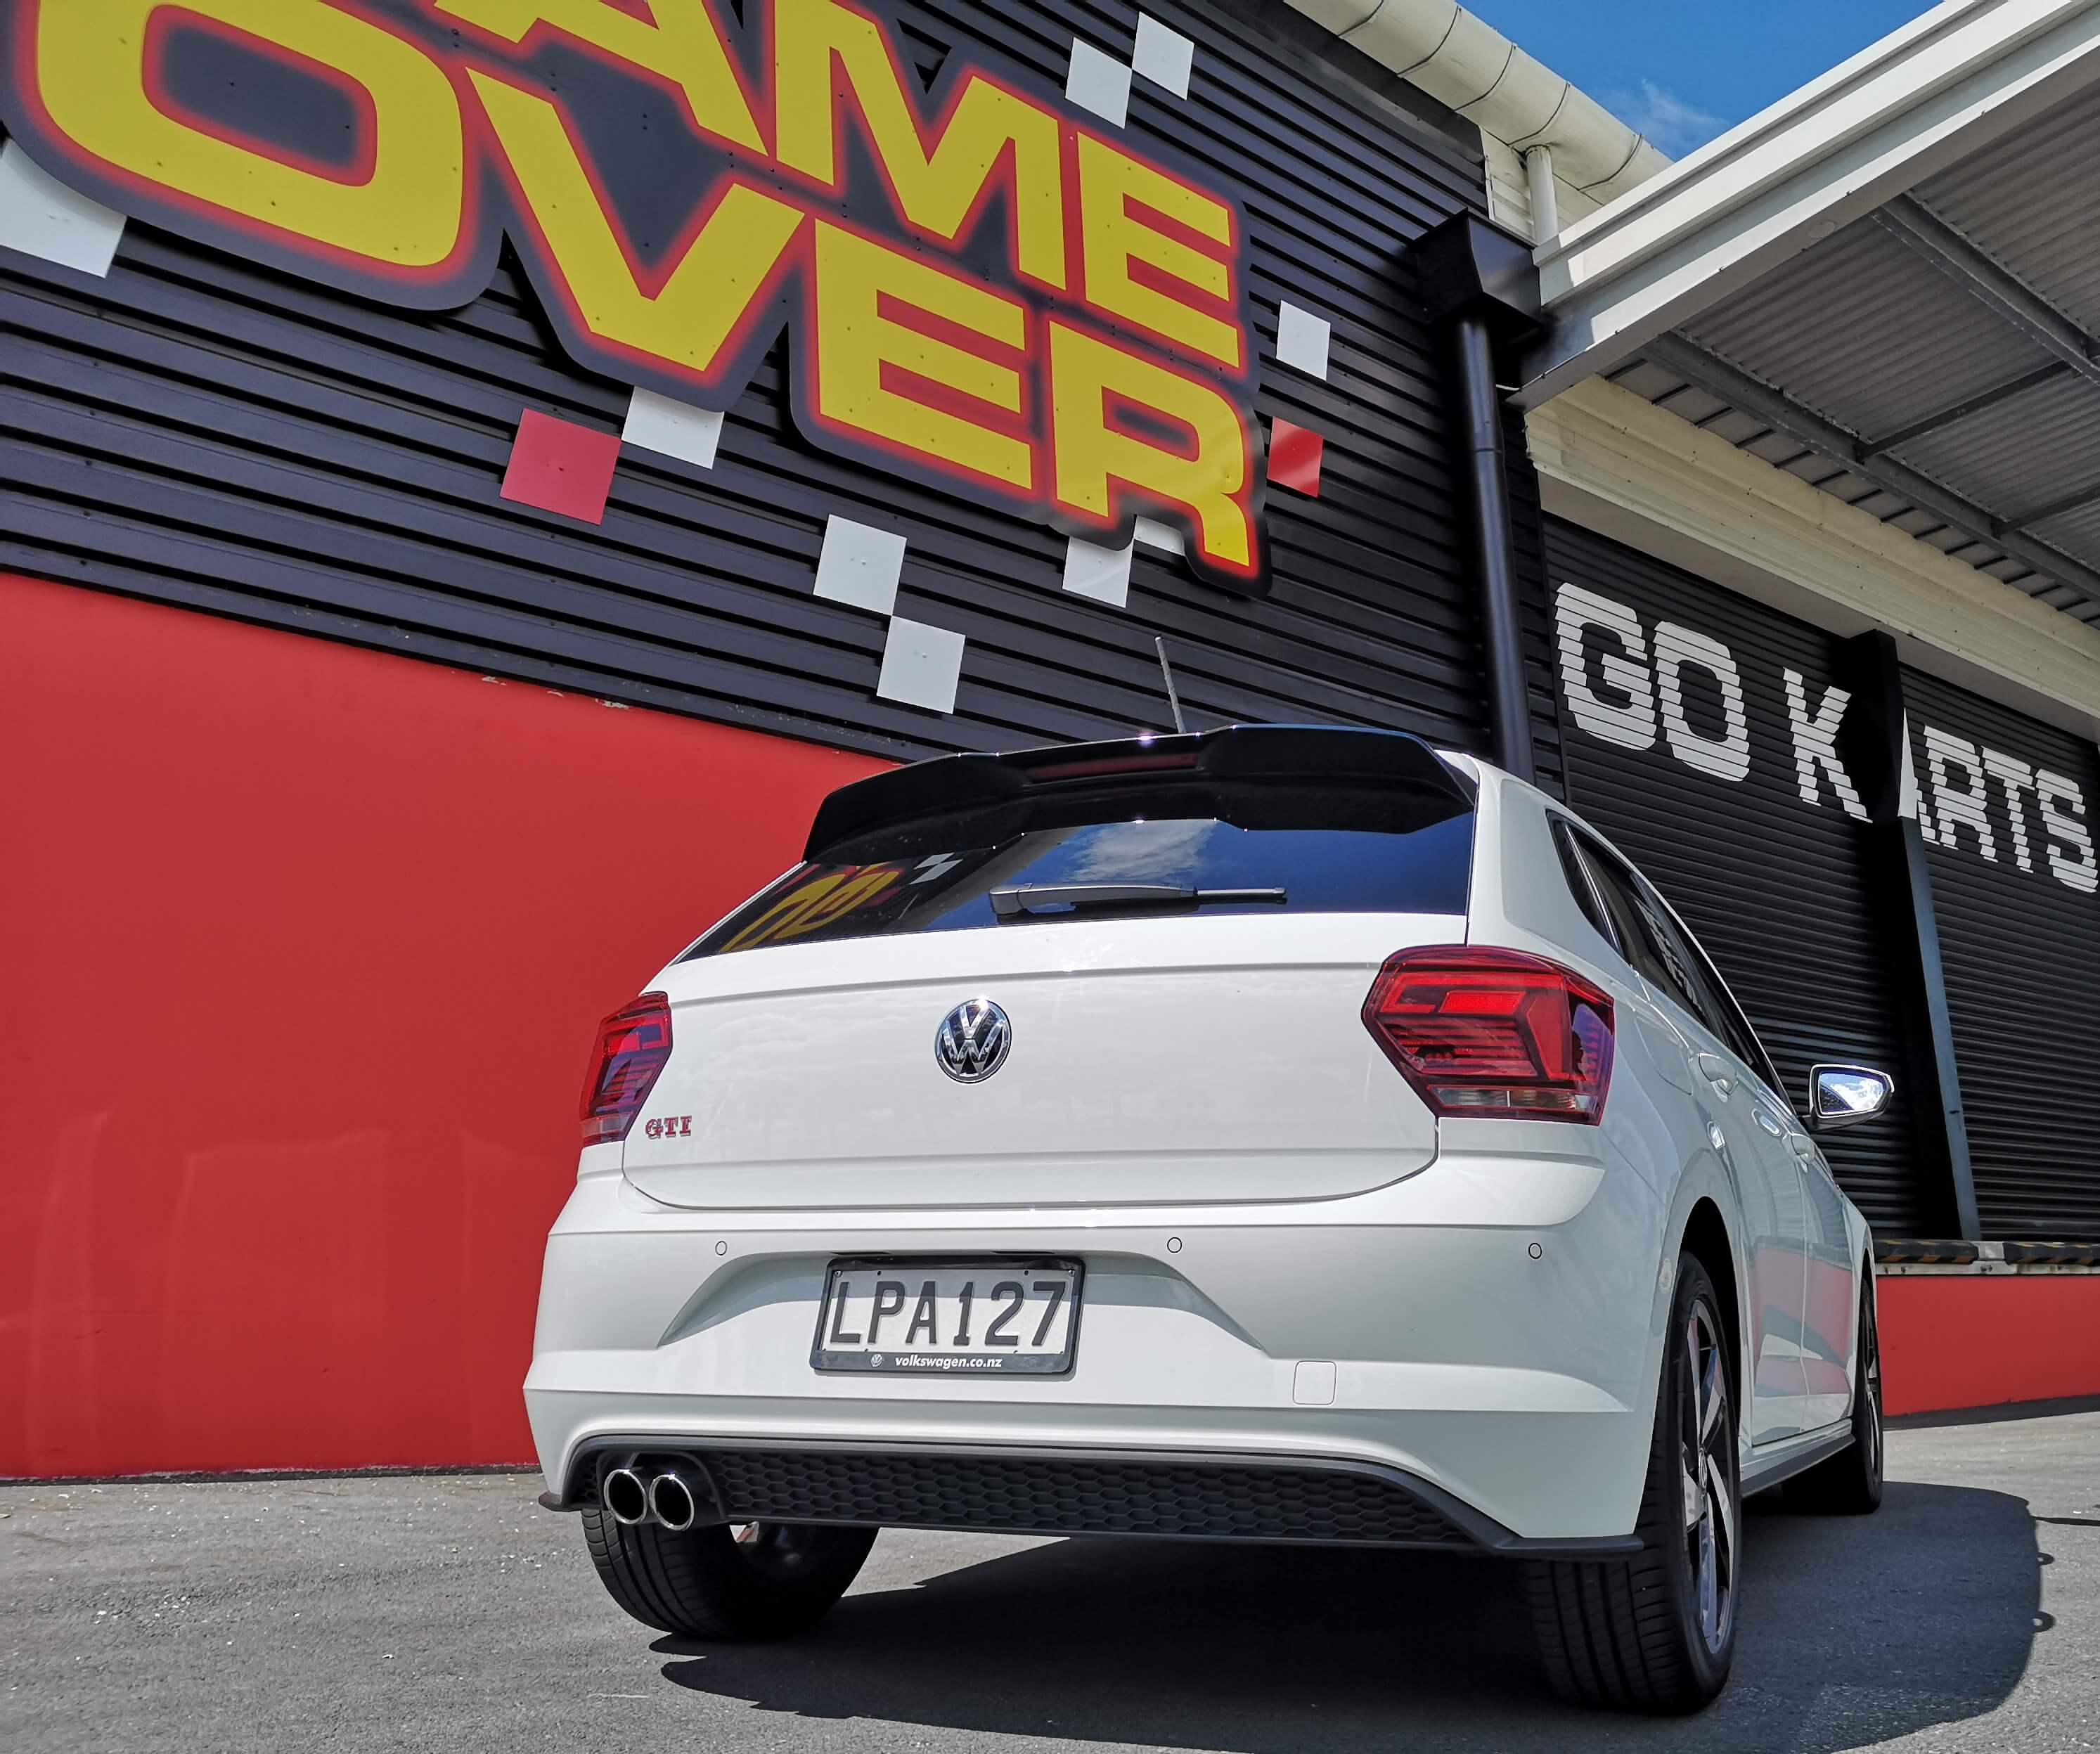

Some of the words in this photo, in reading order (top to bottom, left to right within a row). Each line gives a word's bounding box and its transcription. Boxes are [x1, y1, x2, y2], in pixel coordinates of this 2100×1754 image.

[38, 0, 1250, 566] OVER
[1554, 582, 1751, 782] GO
[645, 1116, 692, 1140] GTI
[830, 1281, 1067, 1346] LPA127
[895, 1354, 1003, 1369] volkswagen.co.nz
